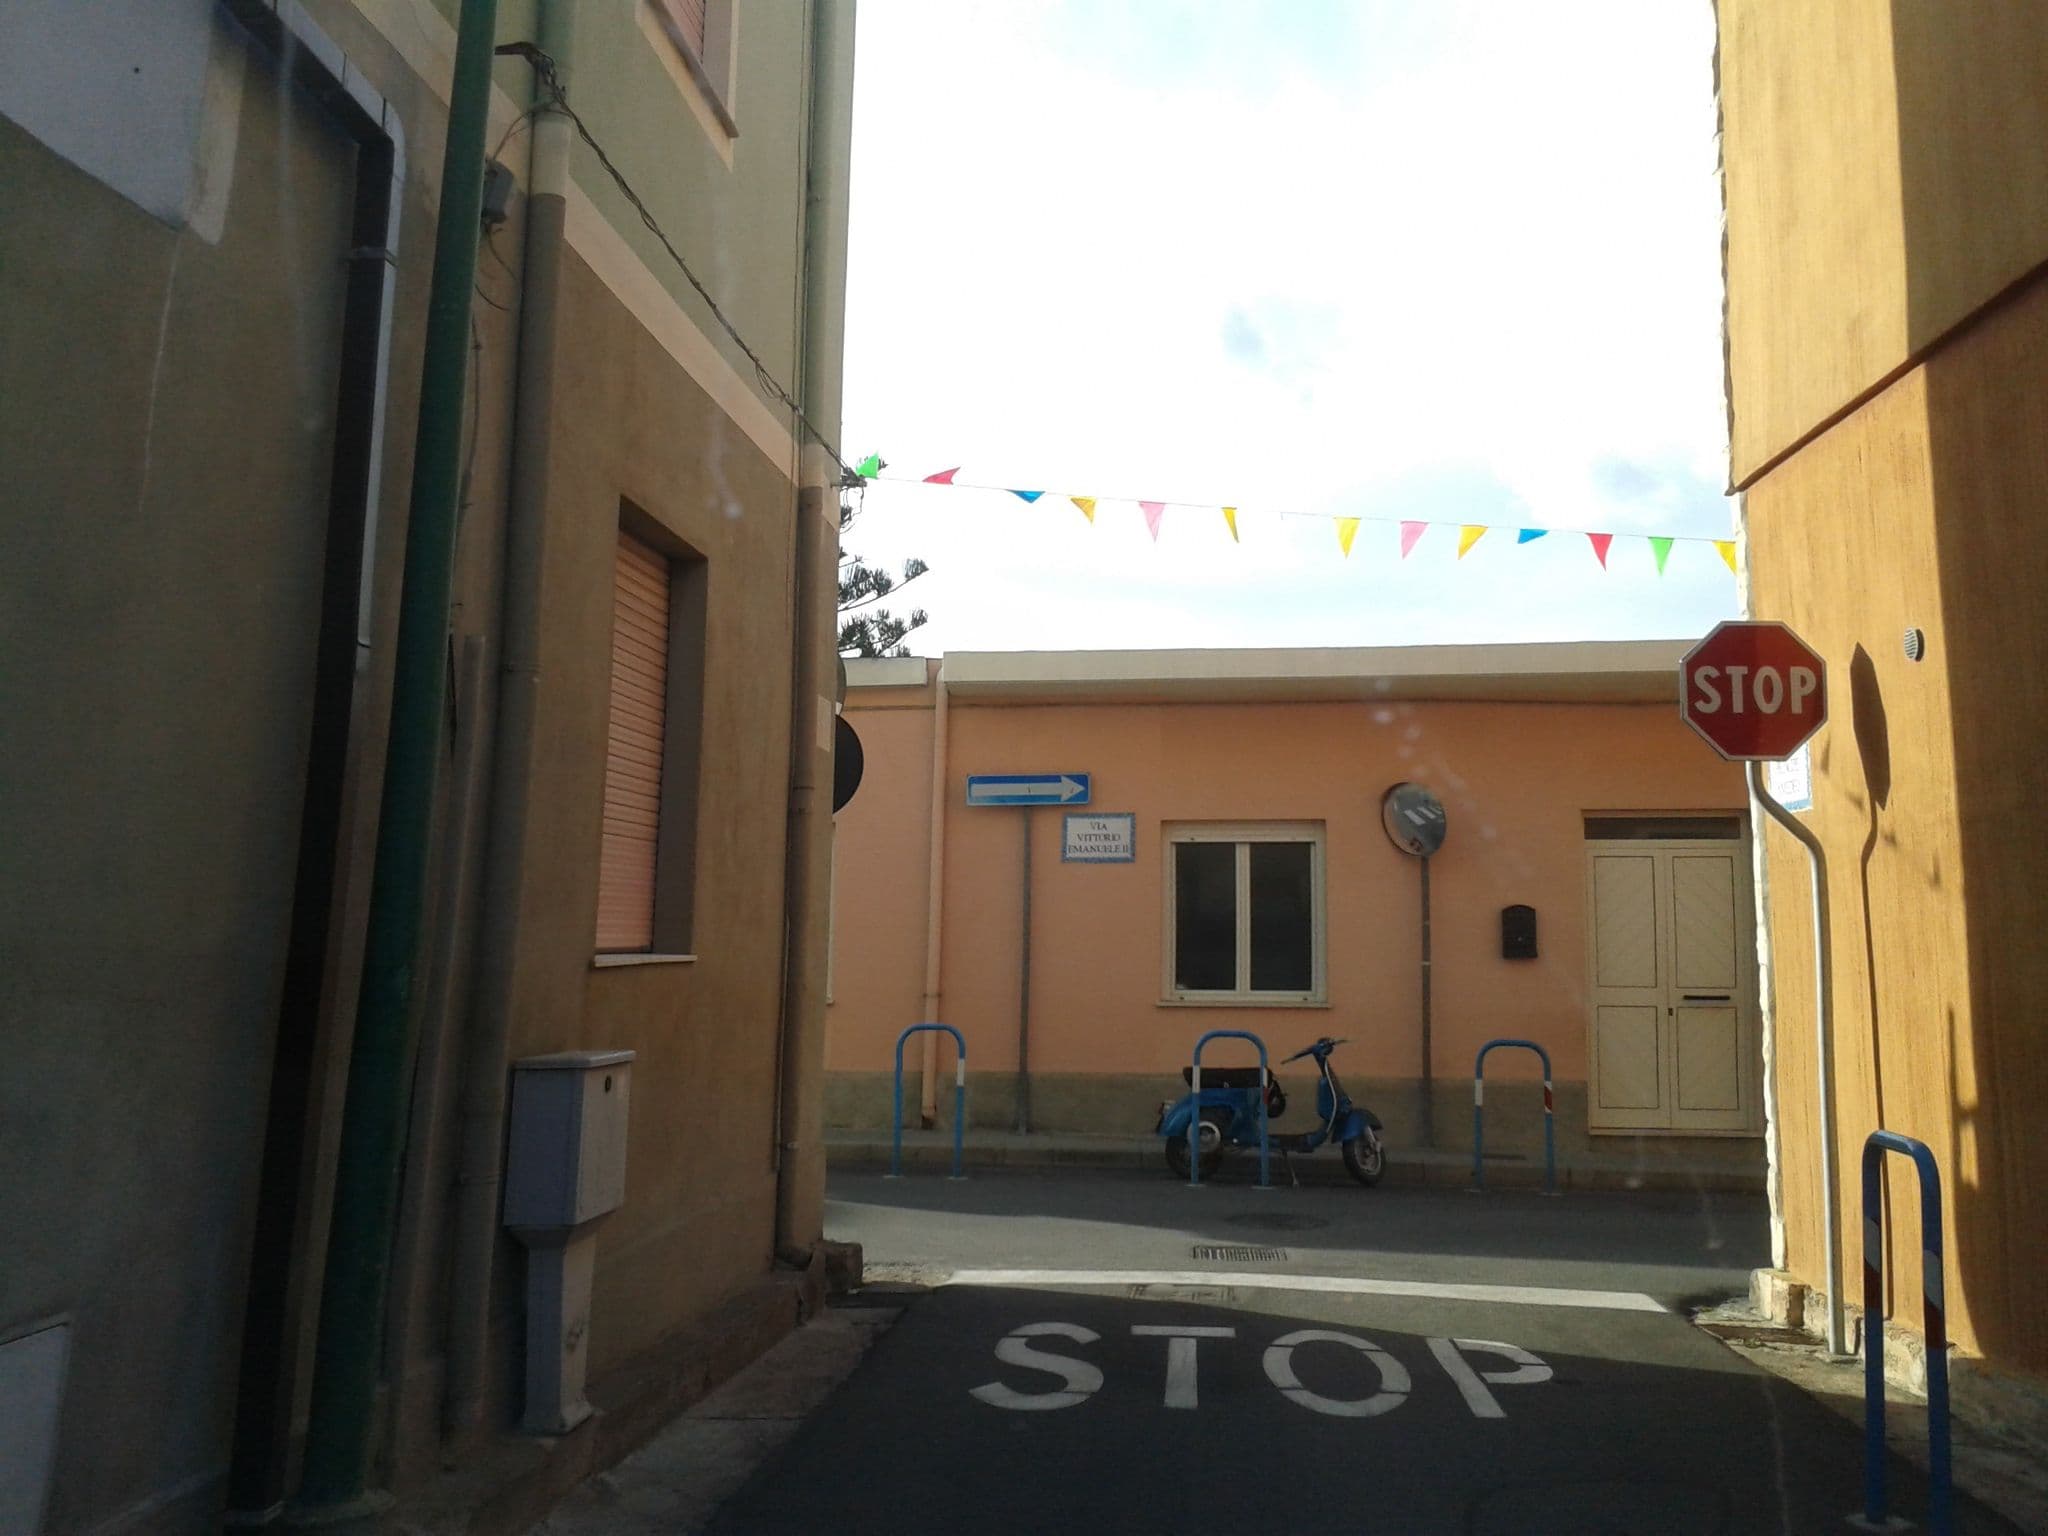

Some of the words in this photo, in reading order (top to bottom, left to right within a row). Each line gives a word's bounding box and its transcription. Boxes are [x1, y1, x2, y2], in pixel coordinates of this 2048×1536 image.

[1694, 665, 1817, 714] STOP
[1089, 821, 1108, 831] VIA
[1076, 833, 1121, 842] VITTORIO
[1068, 844, 1121, 853] EMANUELE
[968, 1321, 1554, 1419] STOP
